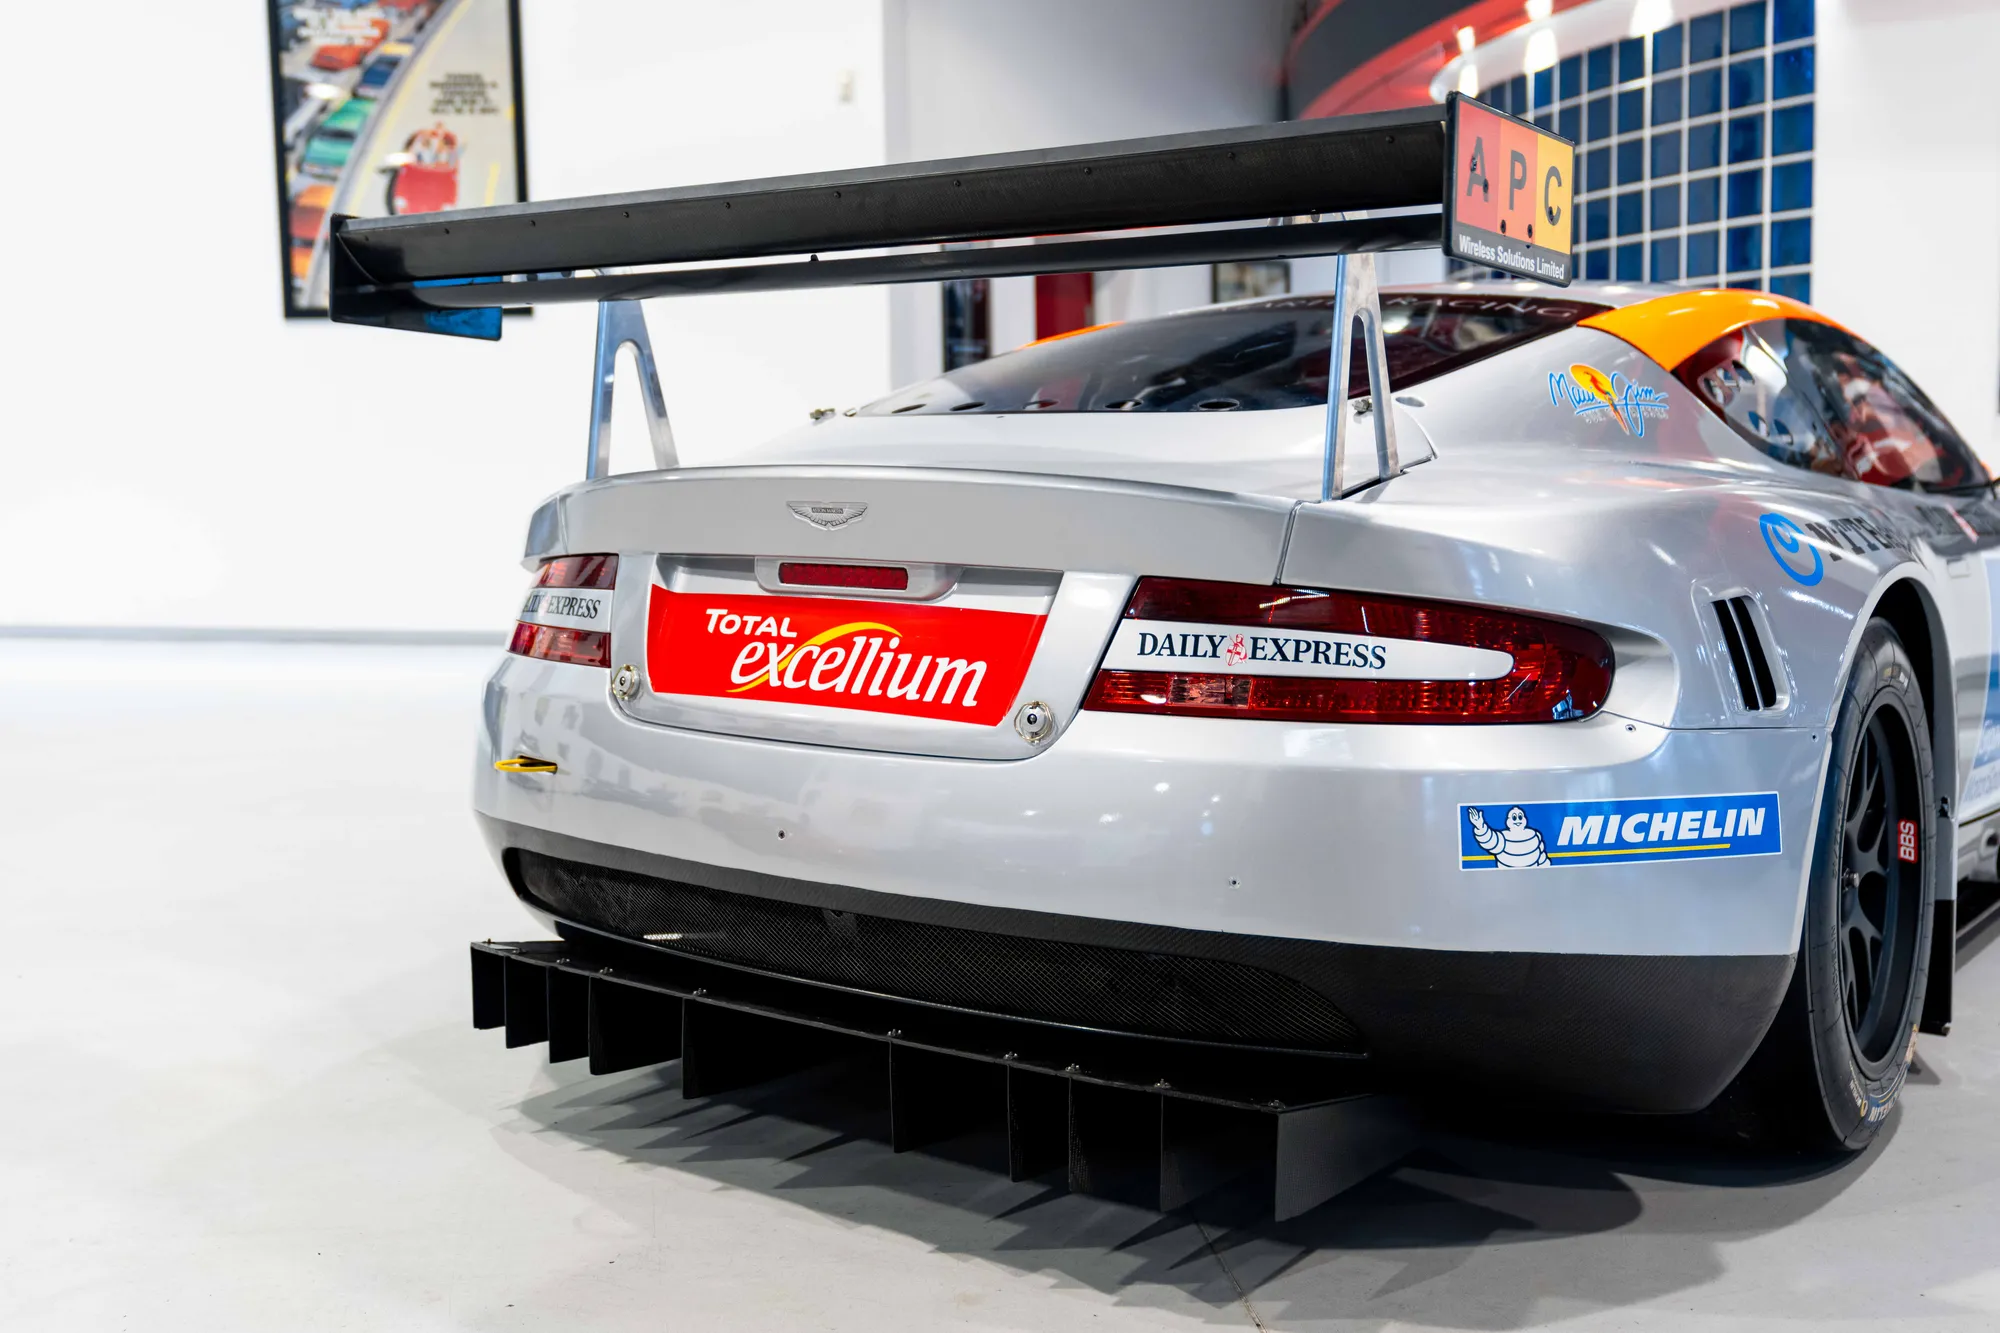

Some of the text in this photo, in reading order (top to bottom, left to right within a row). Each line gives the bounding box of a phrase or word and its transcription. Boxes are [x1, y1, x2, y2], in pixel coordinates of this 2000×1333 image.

[1459, 234, 1565, 280] Wireless Solutions Limited
[1610, 371, 1669, 438] Jim
[546, 595, 602, 619] EXPRESS
[705, 608, 798, 638] TOTAL
[730, 635, 988, 707] excellium
[1137, 632, 1387, 670] DAILY EXPRESS
[1556, 807, 1766, 846] MICHELIN
[1900, 821, 1915, 862] BBS
